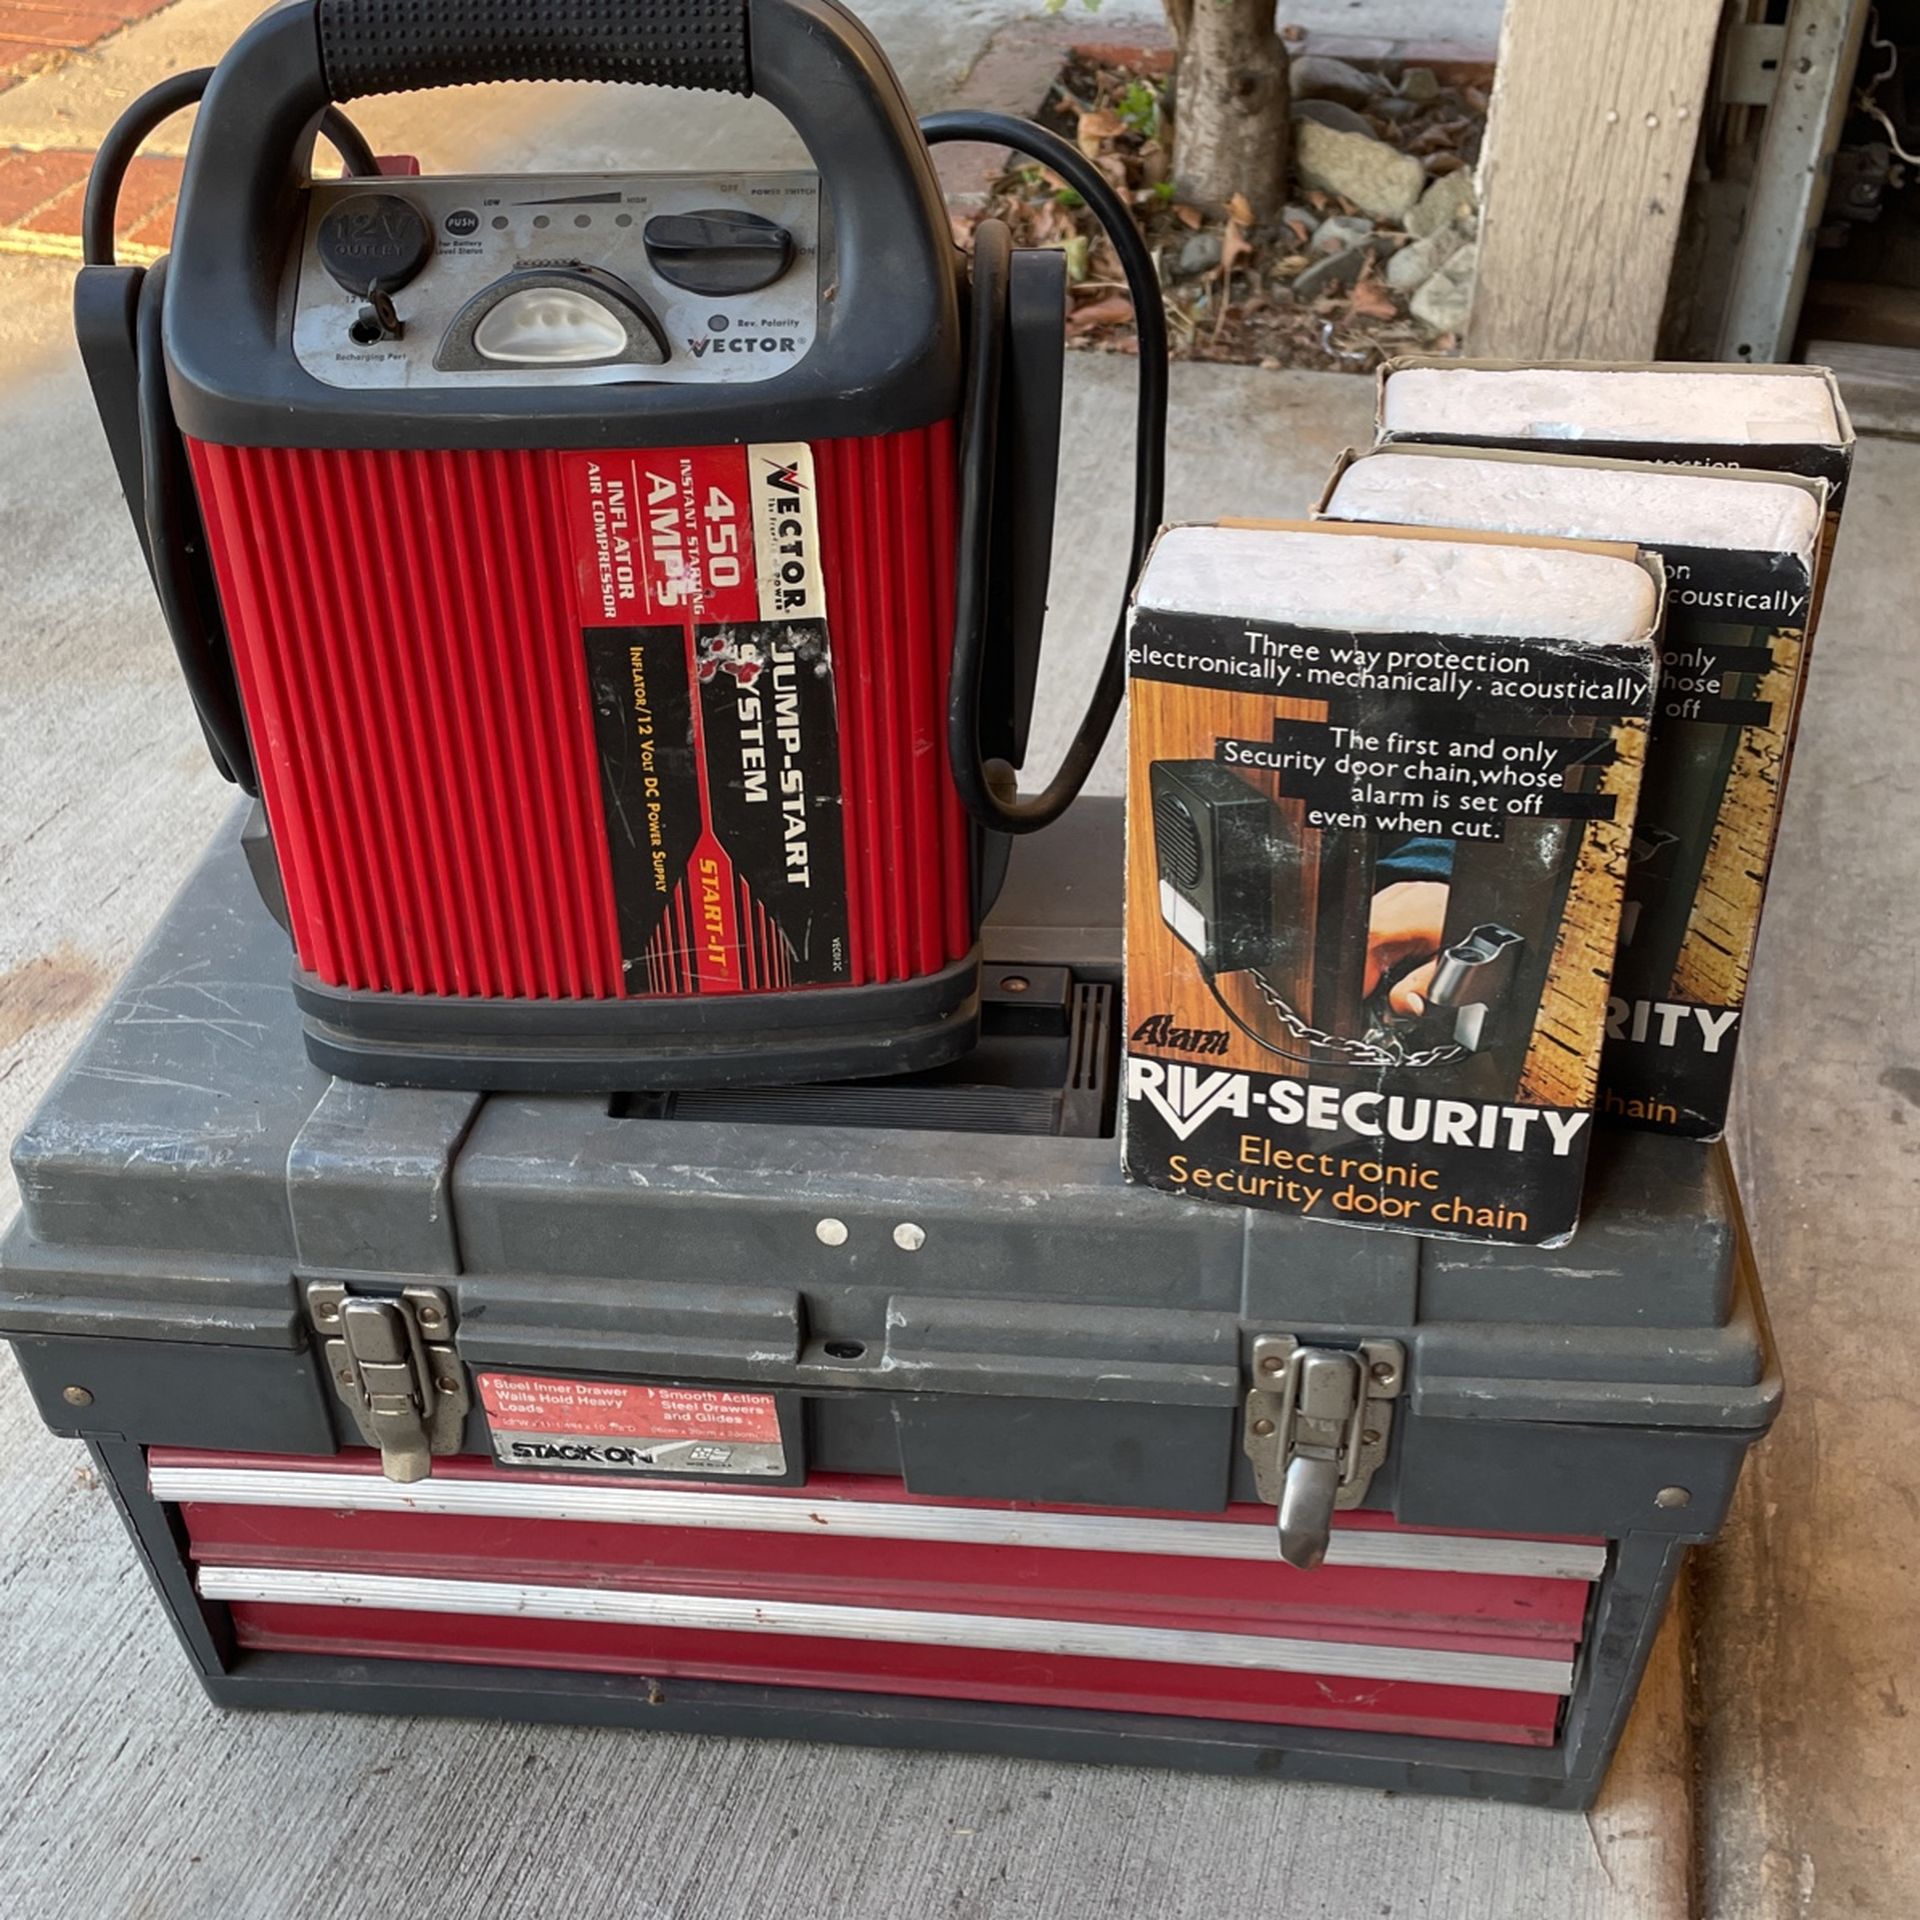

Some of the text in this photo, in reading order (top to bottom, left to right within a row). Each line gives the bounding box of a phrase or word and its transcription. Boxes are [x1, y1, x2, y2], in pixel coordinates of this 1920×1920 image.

[721, 184, 739, 193] OFF
[751, 188, 816, 196] POWER SWITCH
[447, 217, 476, 227] PUSH
[335, 243, 403, 257] OUTLET
[453, 240, 482, 248] Battery
[458, 247, 484, 255] Status
[799, 246, 816, 256] ON
[737, 319, 799, 329] Rev. Polarity
[336, 352, 407, 362] Recharging Port
[679, 458, 698, 530] INSTANT
[587, 461, 617, 619] AIR COMPRESSOR
[606, 480, 636, 599] INFLATOR
[644, 470, 688, 607] AMPS
[703, 486, 741, 588] 450
[774, 573, 783, 611] POWER
[1666, 589, 1804, 617] coustically
[1243, 631, 1530, 674] Three way protection
[1662, 647, 1717, 677] only
[1128, 643, 1648, 706] electronically mechanically acoustically
[1662, 669, 1721, 694] hose
[1665, 698, 1701, 720] off
[1223, 740, 1327, 777] Security
[1334, 753, 1400, 778] door
[1328, 726, 1559, 771] The first and only
[770, 641, 810, 889] JUMP-START
[643, 777, 660, 798] DC
[1350, 782, 1544, 815] alarm is set off
[1307, 809, 1501, 839] even when cut.
[699, 857, 728, 968] START-IT
[1131, 1014, 1231, 1056] Alarm
[1604, 1087, 1678, 1125] hain
[1238, 1133, 1440, 1190] Electronic
[1167, 1154, 1529, 1232] Security door chain
[493, 1378, 629, 1397] Steel Inner Drawer
[495, 1389, 623, 1409] Walls Hold Heavy
[659, 1388, 770, 1405] Smooth Action
[498, 1401, 545, 1414] Loads
[660, 1400, 765, 1415] Steel Drawers
[663, 1411, 743, 1425] and Glides
